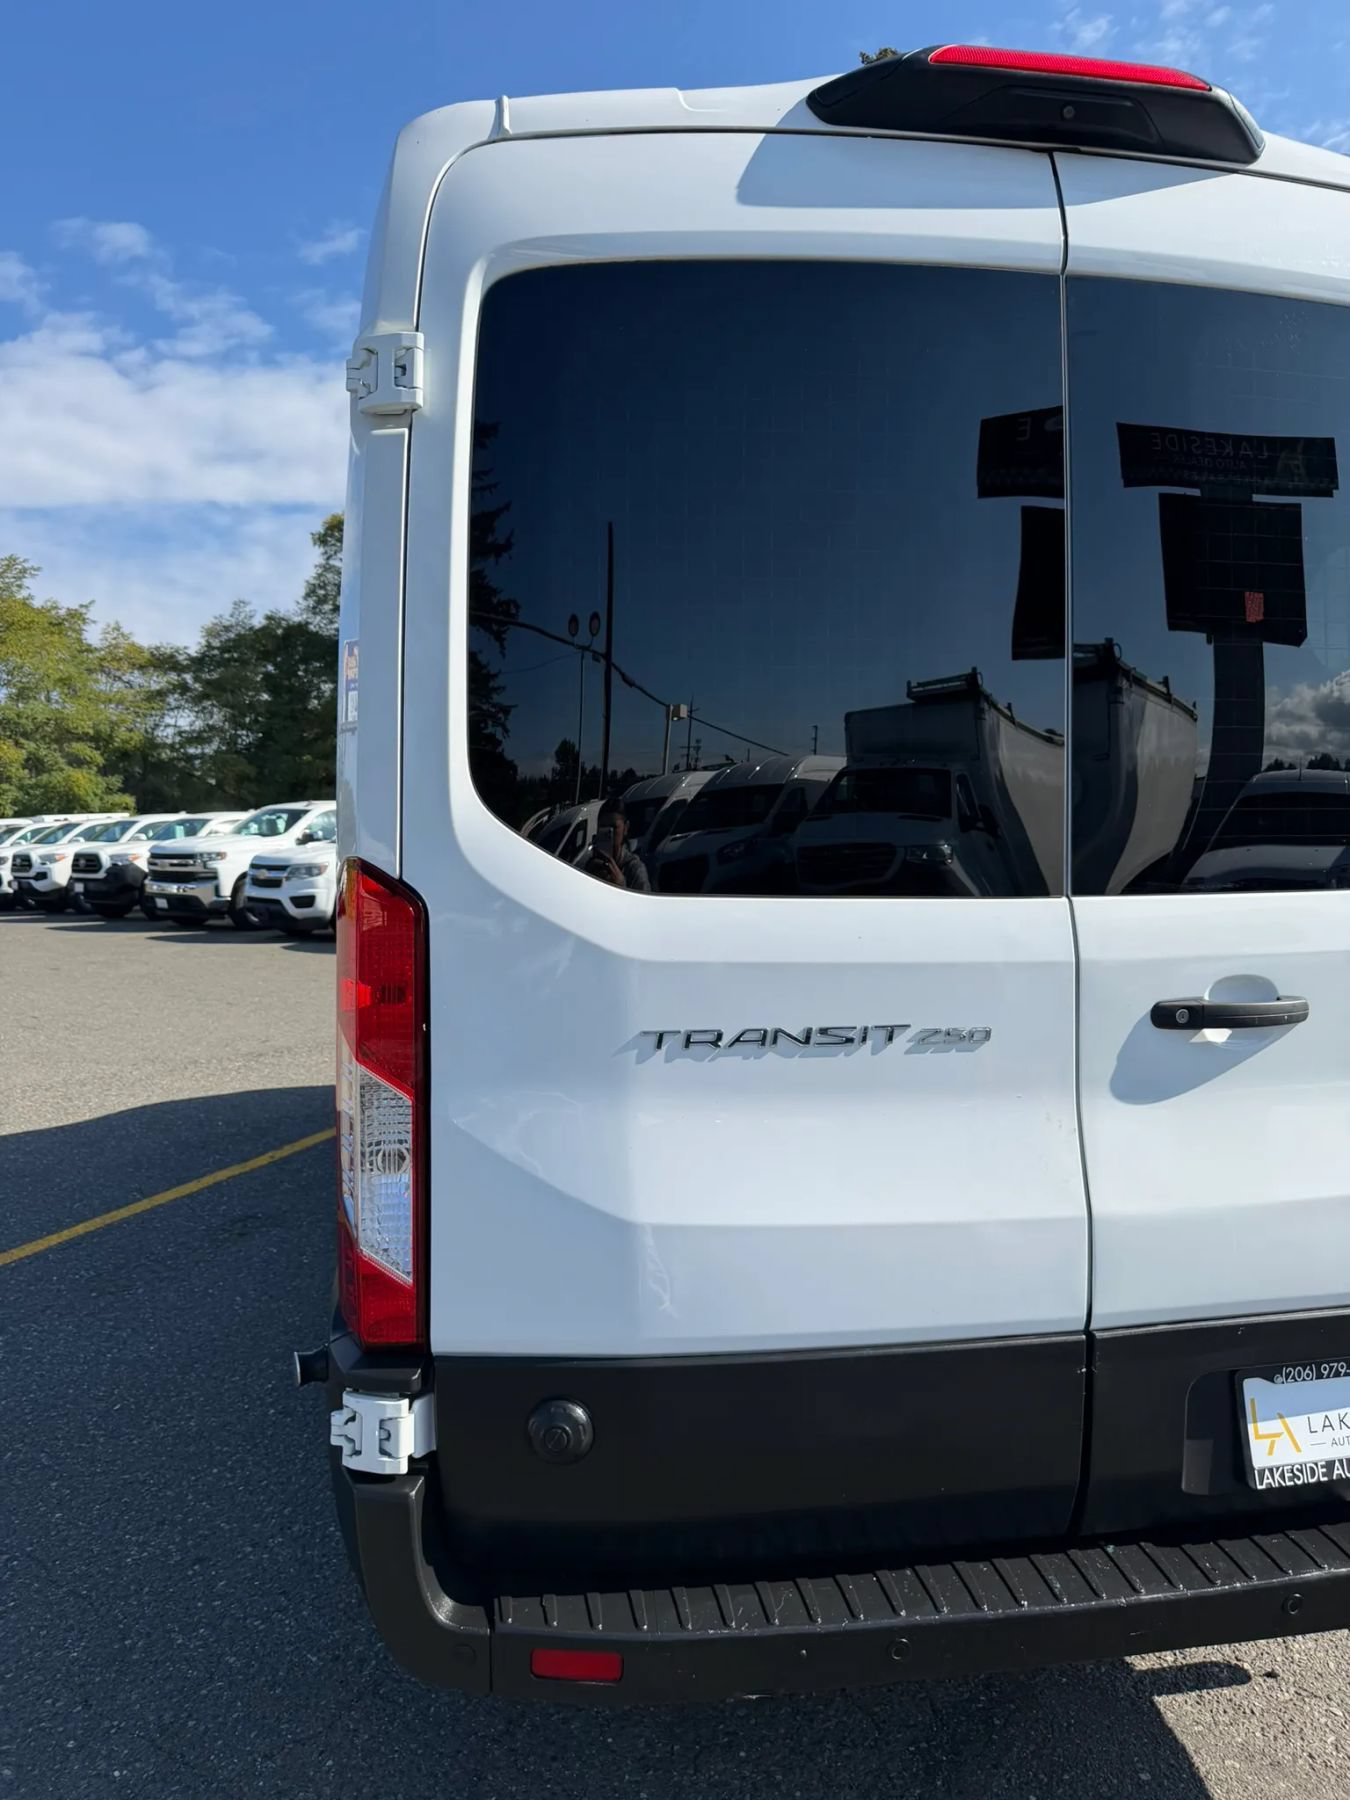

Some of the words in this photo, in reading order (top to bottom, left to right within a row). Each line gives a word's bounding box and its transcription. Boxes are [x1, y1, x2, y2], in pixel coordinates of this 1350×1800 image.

[641, 1023, 912, 1051] TRANSIT
[918, 1026, 992, 1045] 250
[1282, 1363, 1316, 1384] (206)
[1307, 1412, 1350, 1434] LAK
[1254, 1460, 1329, 1490] LAKESIDE
